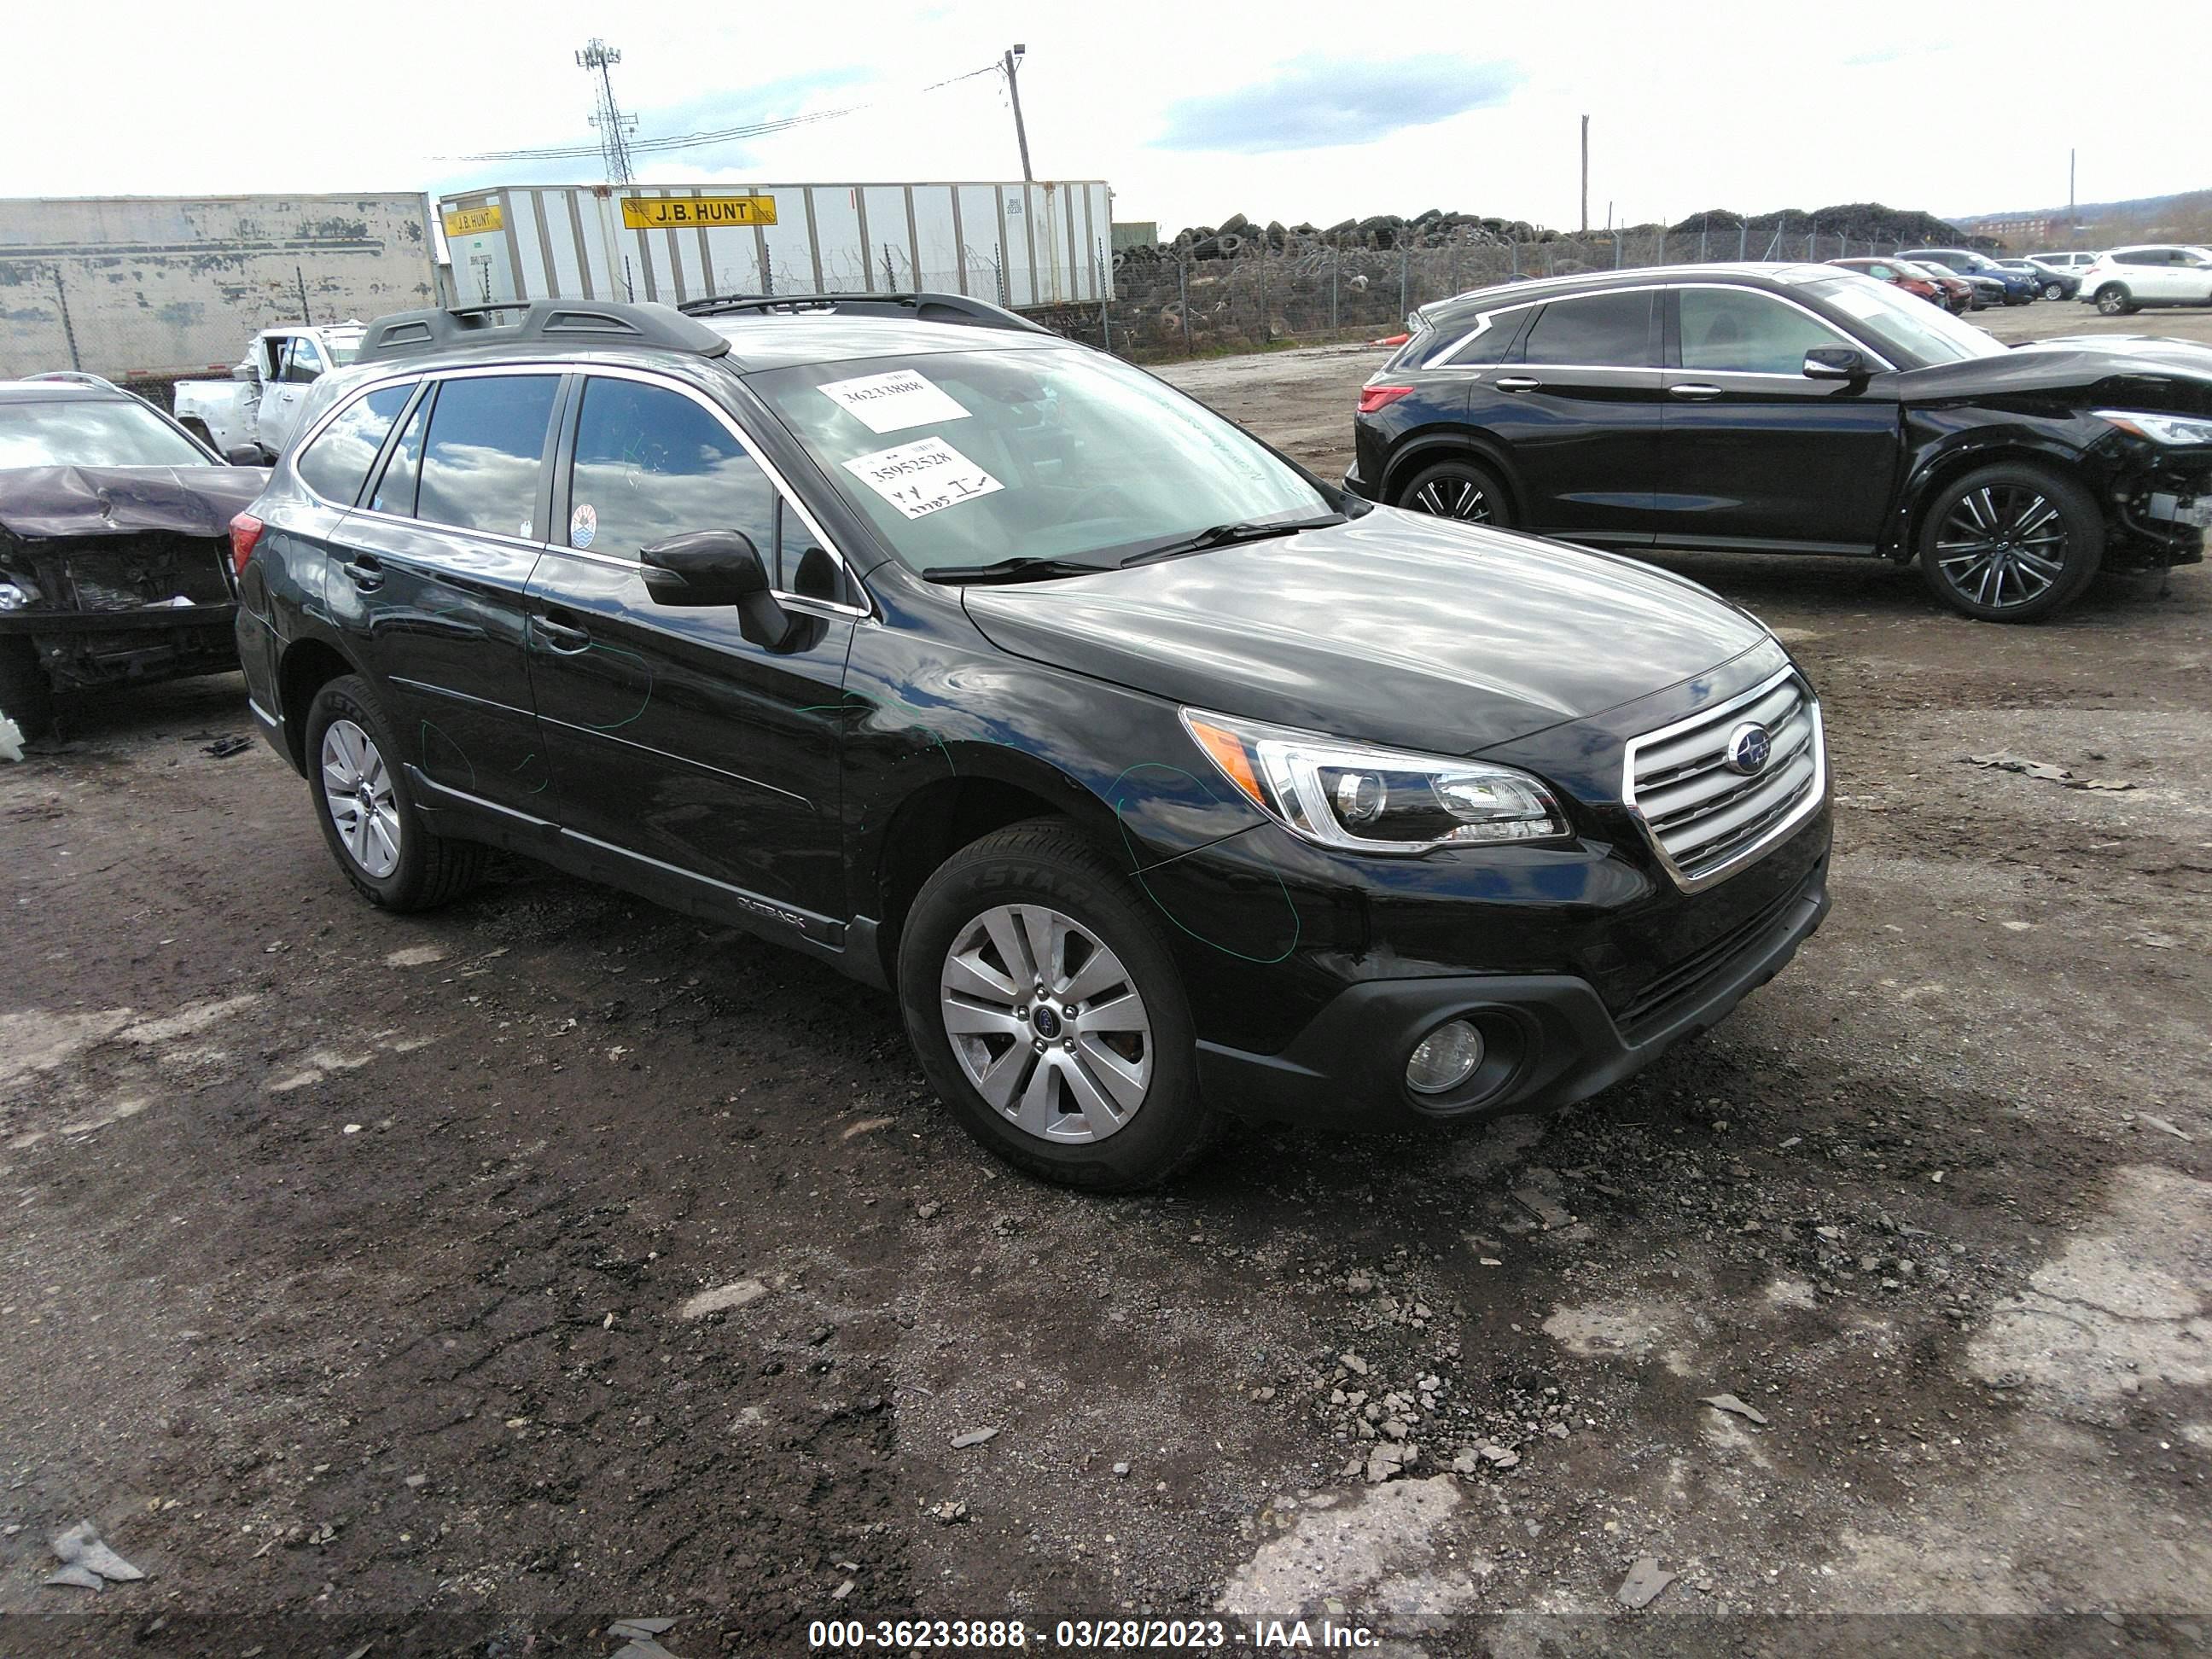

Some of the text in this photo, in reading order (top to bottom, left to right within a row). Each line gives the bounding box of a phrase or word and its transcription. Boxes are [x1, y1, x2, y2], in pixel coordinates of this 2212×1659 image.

[458, 212, 491, 230] J.B. HUNT
[656, 202, 748, 221] J.B. HUNT
[843, 381, 923, 404] 36233888
[870, 452, 952, 482] 35952528
